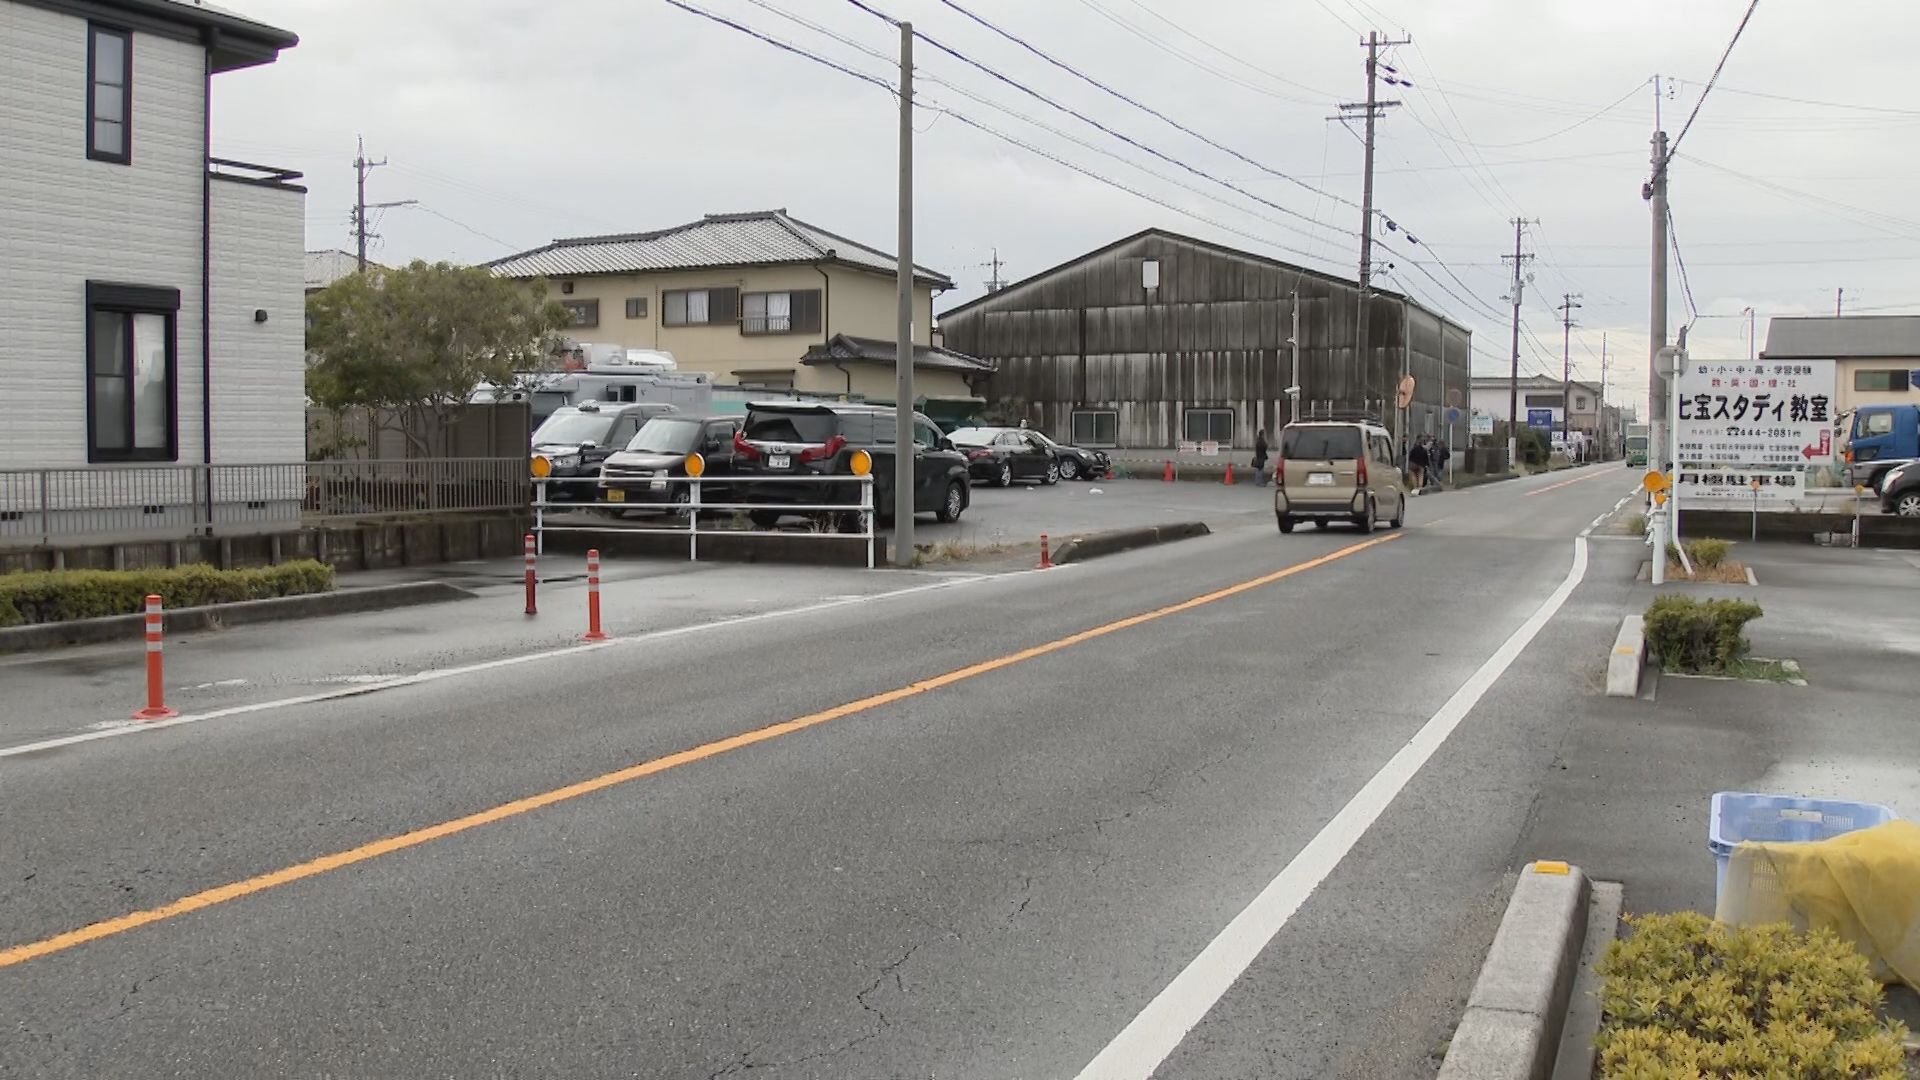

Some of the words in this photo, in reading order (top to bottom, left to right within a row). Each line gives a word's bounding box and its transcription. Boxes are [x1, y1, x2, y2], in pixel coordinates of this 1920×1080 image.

[1679, 393, 1829, 422] 七宝スタディ教室
